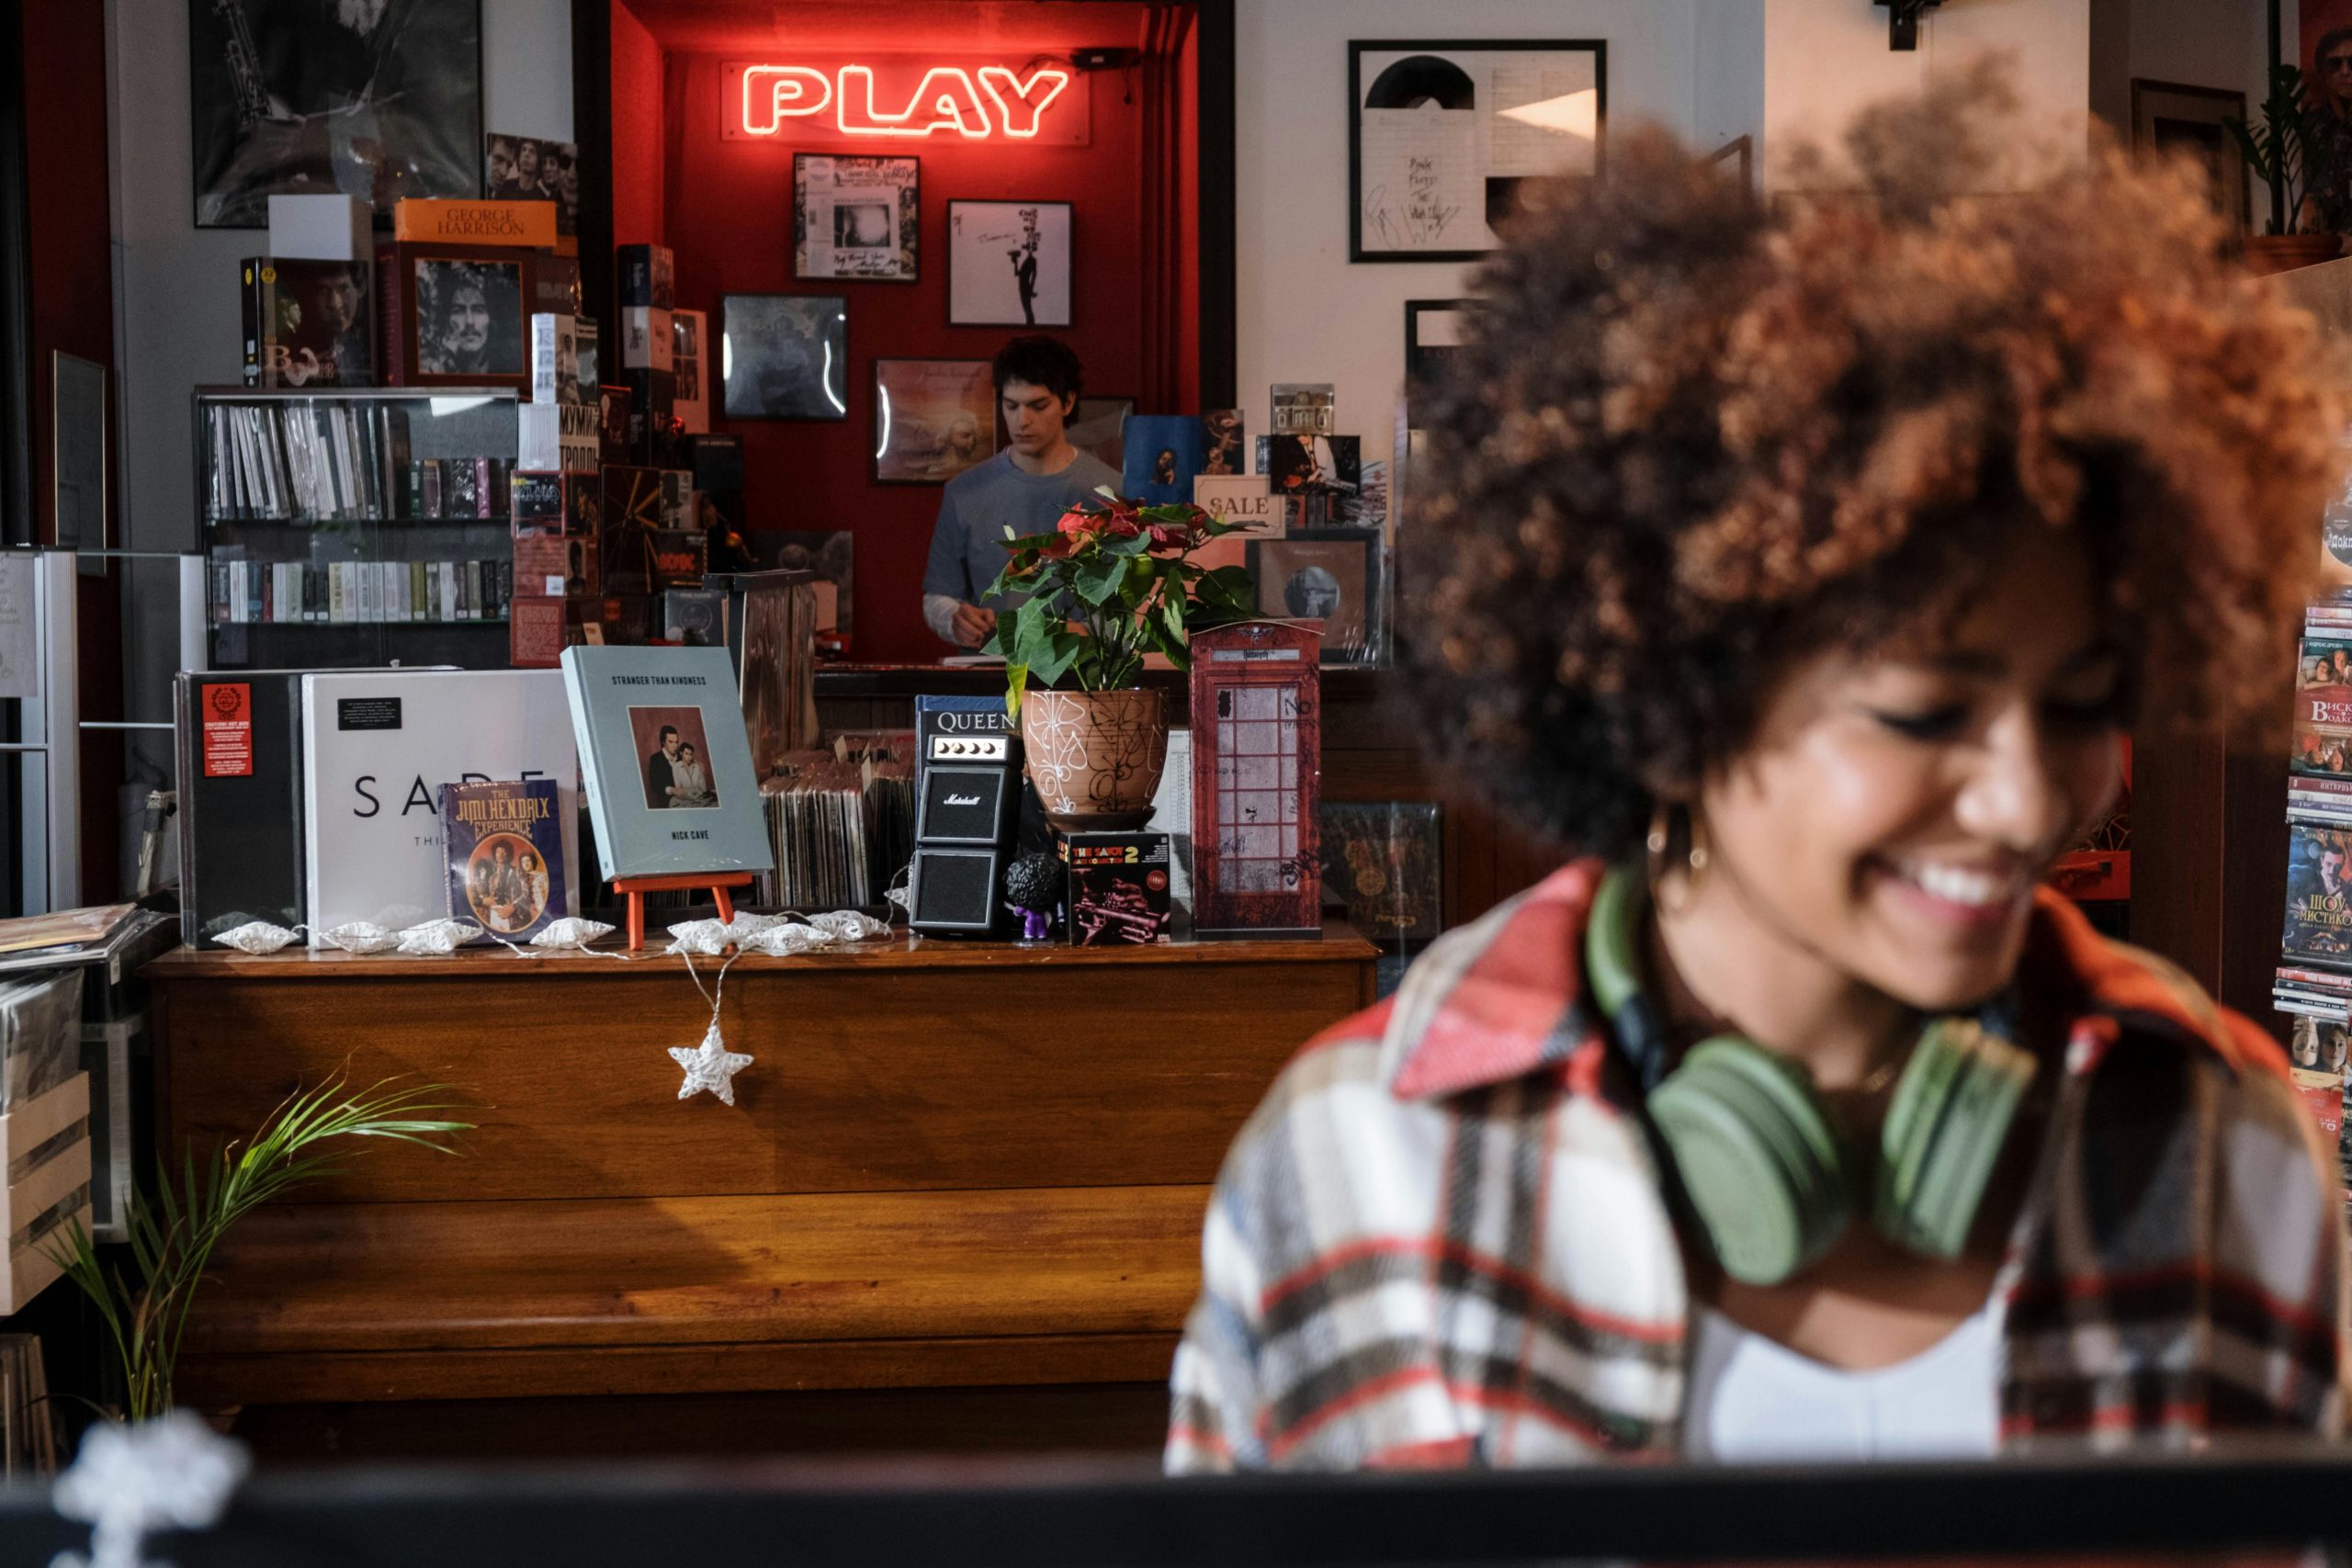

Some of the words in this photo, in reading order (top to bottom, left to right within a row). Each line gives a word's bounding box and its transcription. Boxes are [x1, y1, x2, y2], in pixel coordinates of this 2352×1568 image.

[742, 65, 1069, 138] PLAY
[447, 209, 514, 222] GEORGE
[437, 220, 525, 235] HARRISON
[1209, 497, 1270, 515] SALE
[612, 676, 650, 685] STRANGER
[651, 676, 670, 685] THAN
[672, 676, 707, 686] KINDNESS
[937, 712, 1016, 733] QUEEN
[353, 770, 544, 818] SA
[491, 789, 511, 799] THE
[943, 793, 981, 806] Marshall
[456, 799, 487, 825] JIMI
[489, 797, 550, 824] HENDRIX
[473, 819, 534, 842] EXPERIENCE
[672, 831, 690, 840] NICK
[691, 830, 709, 840] CAVE
[414, 837, 439, 846] THI
[1072, 847, 1091, 858] THE
[1093, 847, 1125, 857] SAVOY
[1124, 845, 1139, 864] 2
[2310, 894, 2346, 912] ШОУ
[2299, 910, 2352, 927] МИСТИКО
